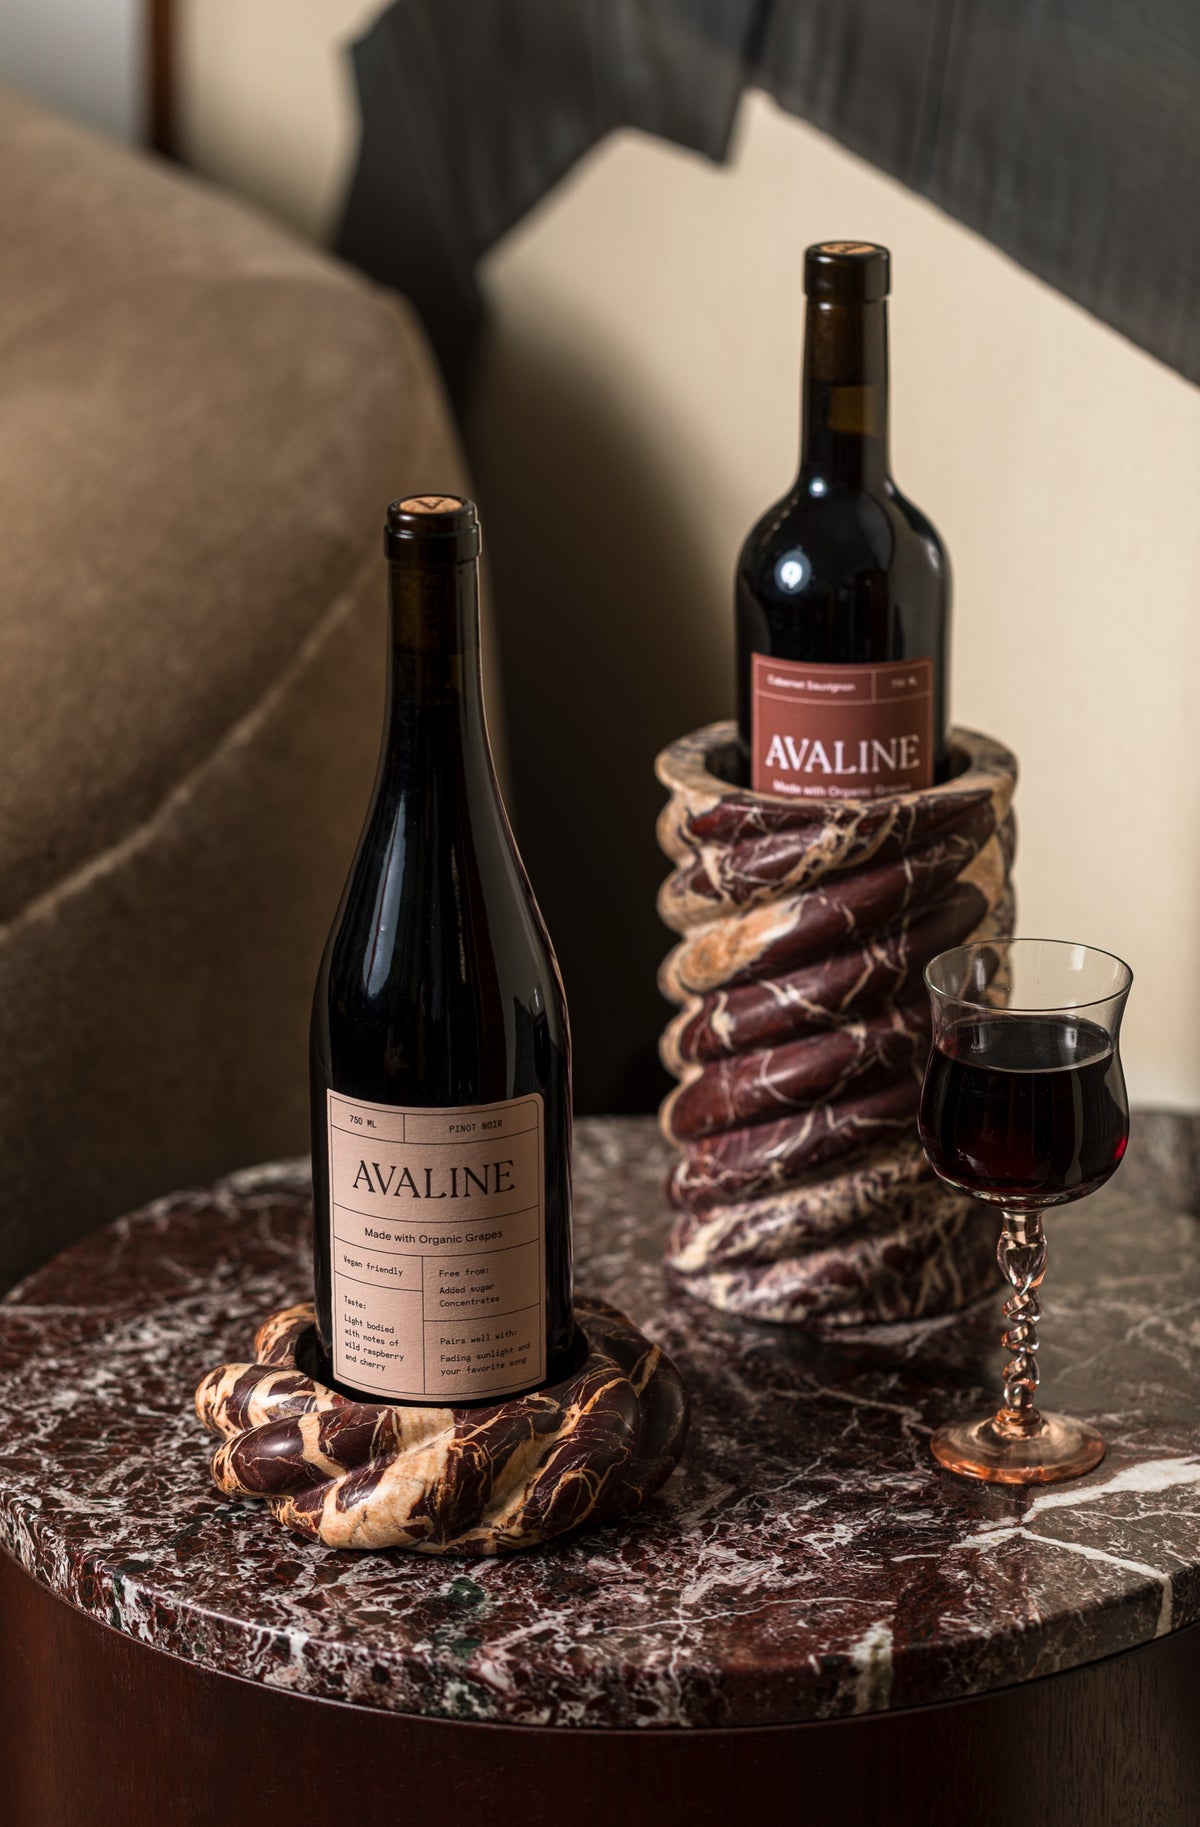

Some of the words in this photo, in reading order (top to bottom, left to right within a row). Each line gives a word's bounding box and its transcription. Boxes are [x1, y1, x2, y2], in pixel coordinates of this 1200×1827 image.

[765, 734, 921, 775] AVALINE
[349, 1114, 364, 1126] 750
[366, 1119, 377, 1129] ML
[449, 1123, 477, 1133] PINOT
[481, 1119, 504, 1130] NOIR
[352, 1159, 516, 1199] AVALINE
[364, 1227, 392, 1241] Made
[394, 1233, 416, 1244] with
[418, 1234, 463, 1247] Organic
[465, 1229, 504, 1244] Grapes
[343, 1254, 363, 1269] Vegan
[366, 1262, 404, 1278] friendly
[438, 1269, 460, 1278] Free
[464, 1267, 490, 1276] from:
[439, 1286, 466, 1295] Added
[470, 1283, 495, 1294] sugar
[343, 1295, 367, 1310] Taste:
[439, 1296, 500, 1308] Concentrates
[344, 1313, 363, 1327] Light
[366, 1321, 395, 1335] bodied
[344, 1328, 360, 1339] with
[362, 1333, 385, 1346] notes
[389, 1339, 399, 1347] of
[439, 1337, 466, 1345] Pairs
[470, 1334, 490, 1343] well
[494, 1329, 518, 1340] with:
[344, 1340, 361, 1352] wild
[363, 1347, 405, 1361] raspberry
[440, 1354, 472, 1363] Fading
[476, 1347, 514, 1360] sunlight
[518, 1342, 531, 1353] and
[345, 1353, 357, 1363] and
[359, 1358, 386, 1371] cherry
[440, 1368, 462, 1376] your
[466, 1362, 506, 1374] favorite
[509, 1356, 527, 1366] song
